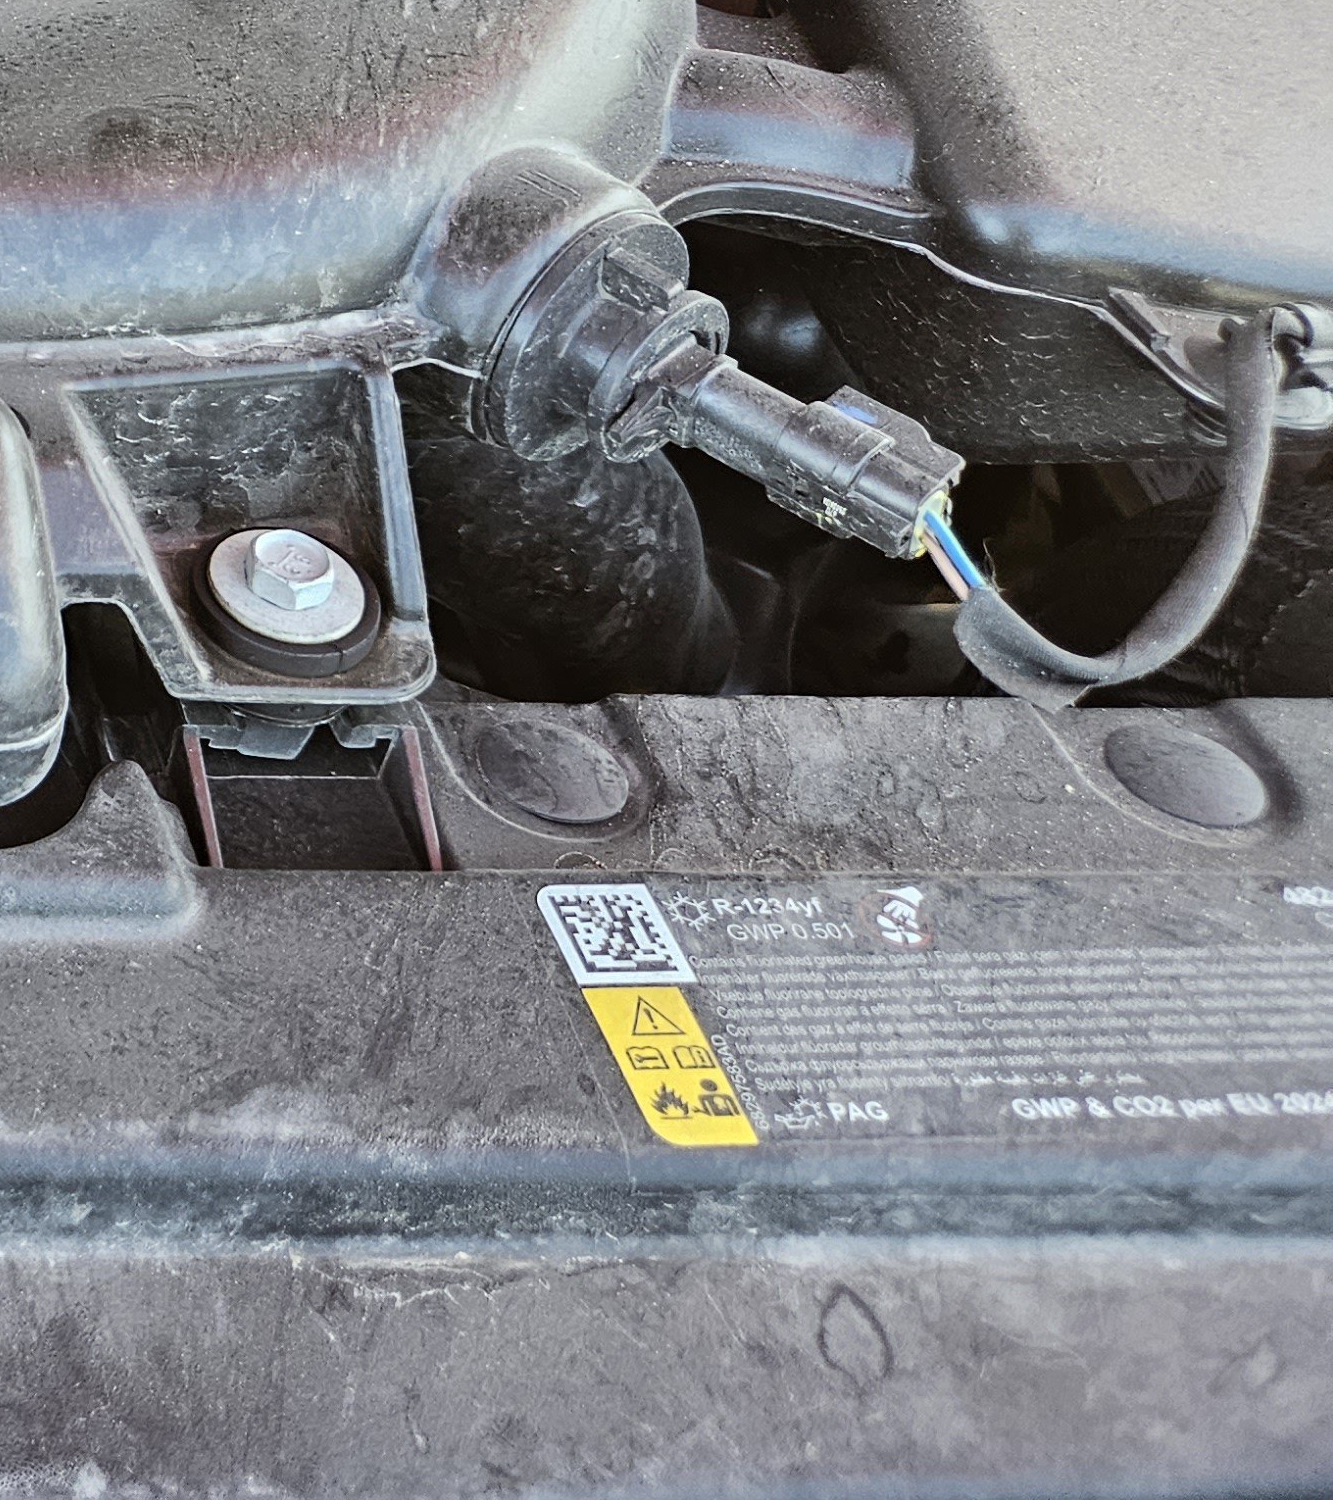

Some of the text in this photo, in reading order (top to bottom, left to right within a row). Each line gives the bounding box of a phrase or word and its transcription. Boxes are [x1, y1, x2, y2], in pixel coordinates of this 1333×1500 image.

[711, 897, 824, 919] R-1234yf
[726, 922, 856, 941] GWP 0.501
[827, 1101, 890, 1122] PAG
[1011, 1096, 1081, 1120] GWP
[1084, 1096, 1116, 1119] &
[1113, 1095, 1182, 1118] CO2
[1226, 1091, 1279, 1116] EU
